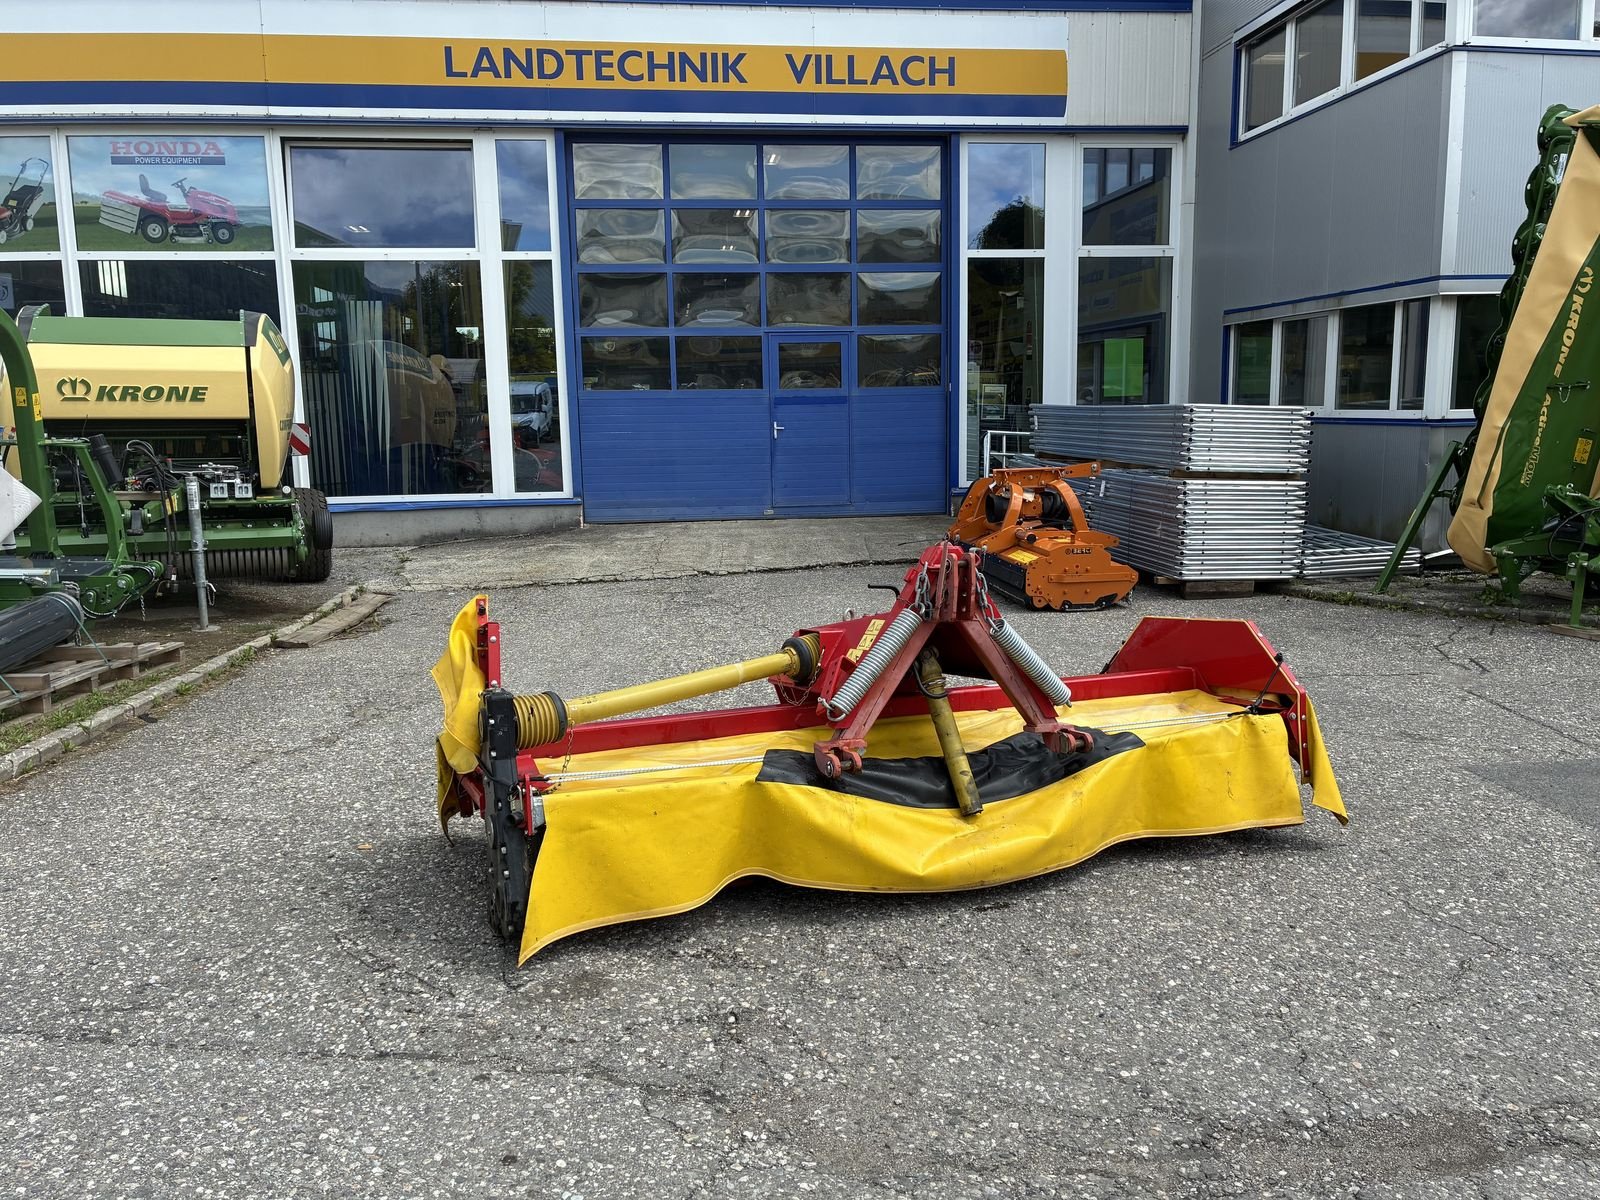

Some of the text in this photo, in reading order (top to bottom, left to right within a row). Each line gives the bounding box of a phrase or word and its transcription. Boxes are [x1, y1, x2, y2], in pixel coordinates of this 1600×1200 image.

[444, 45, 956, 87] LANDTECHNIK VILLACH
[110, 141, 225, 155] HONDA
[1553, 294, 1585, 378] KRONE
[95, 385, 209, 402] KRONE
